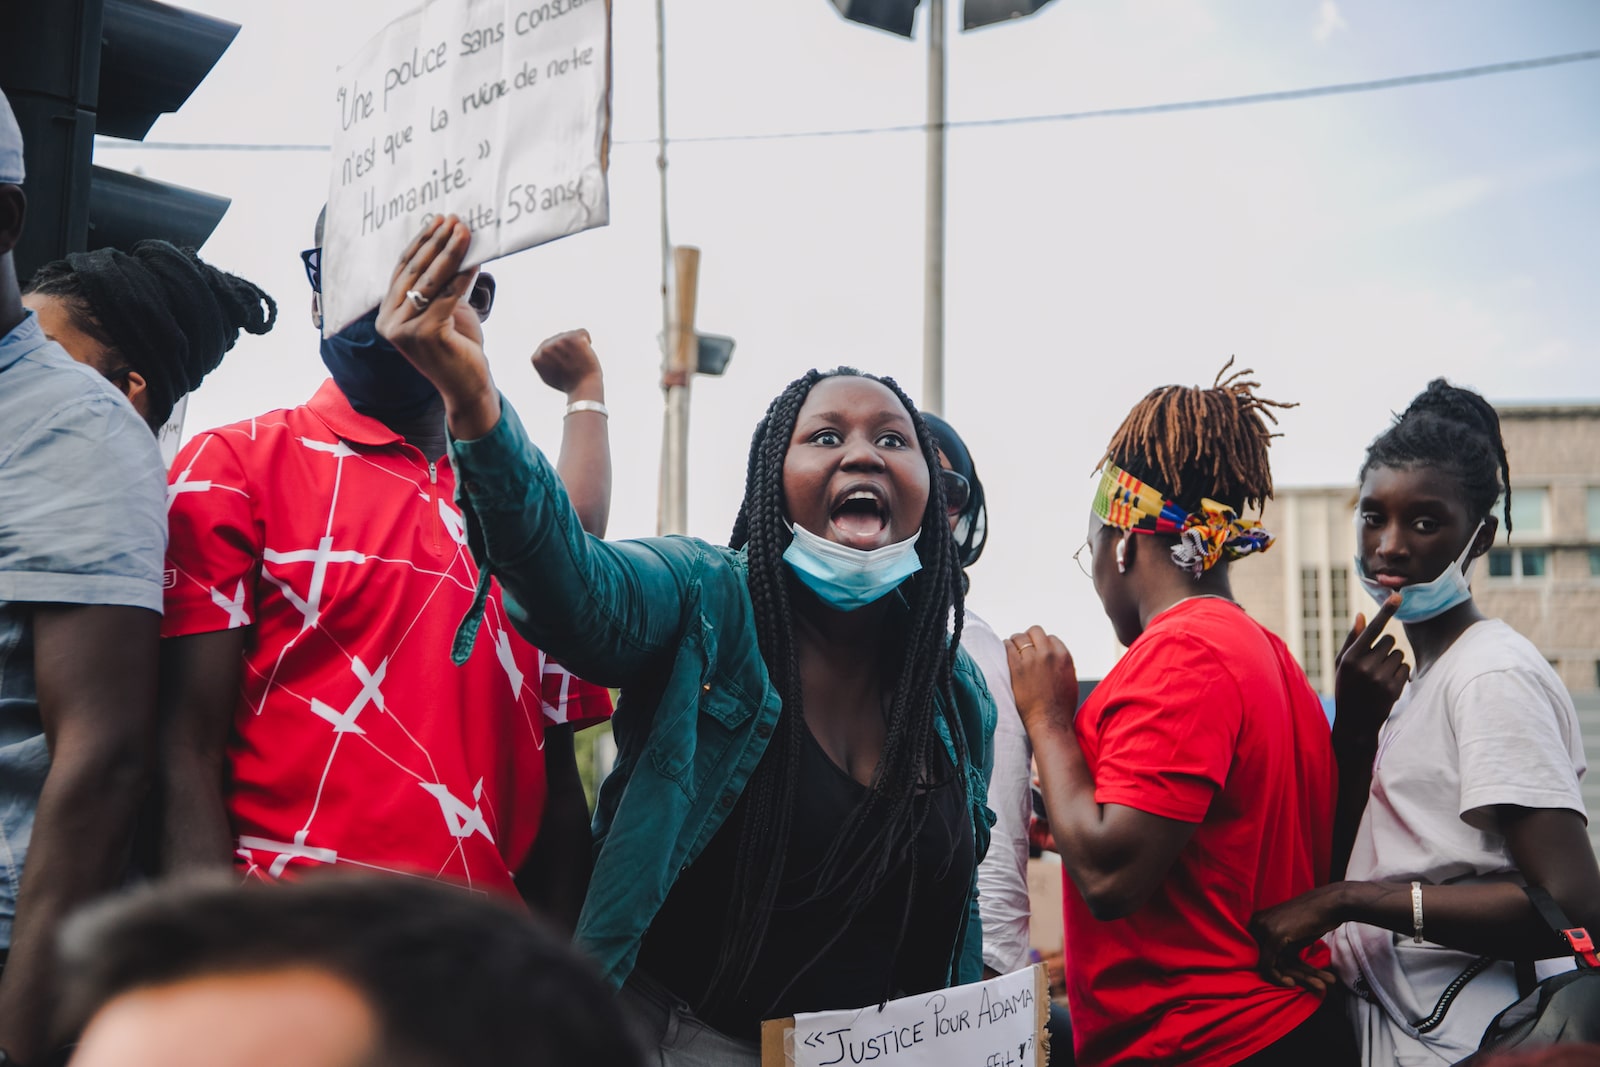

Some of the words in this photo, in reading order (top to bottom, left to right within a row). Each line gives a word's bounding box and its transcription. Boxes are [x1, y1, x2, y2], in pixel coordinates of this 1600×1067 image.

[459, 22, 504, 56] sans
[384, 125, 413, 165] que
[430, 105, 448, 133] la
[461, 79, 511, 115] ruine
[514, 60, 538, 90] de
[546, 46, 593, 79] notre
[977, 987, 1034, 1028] ADAMA
